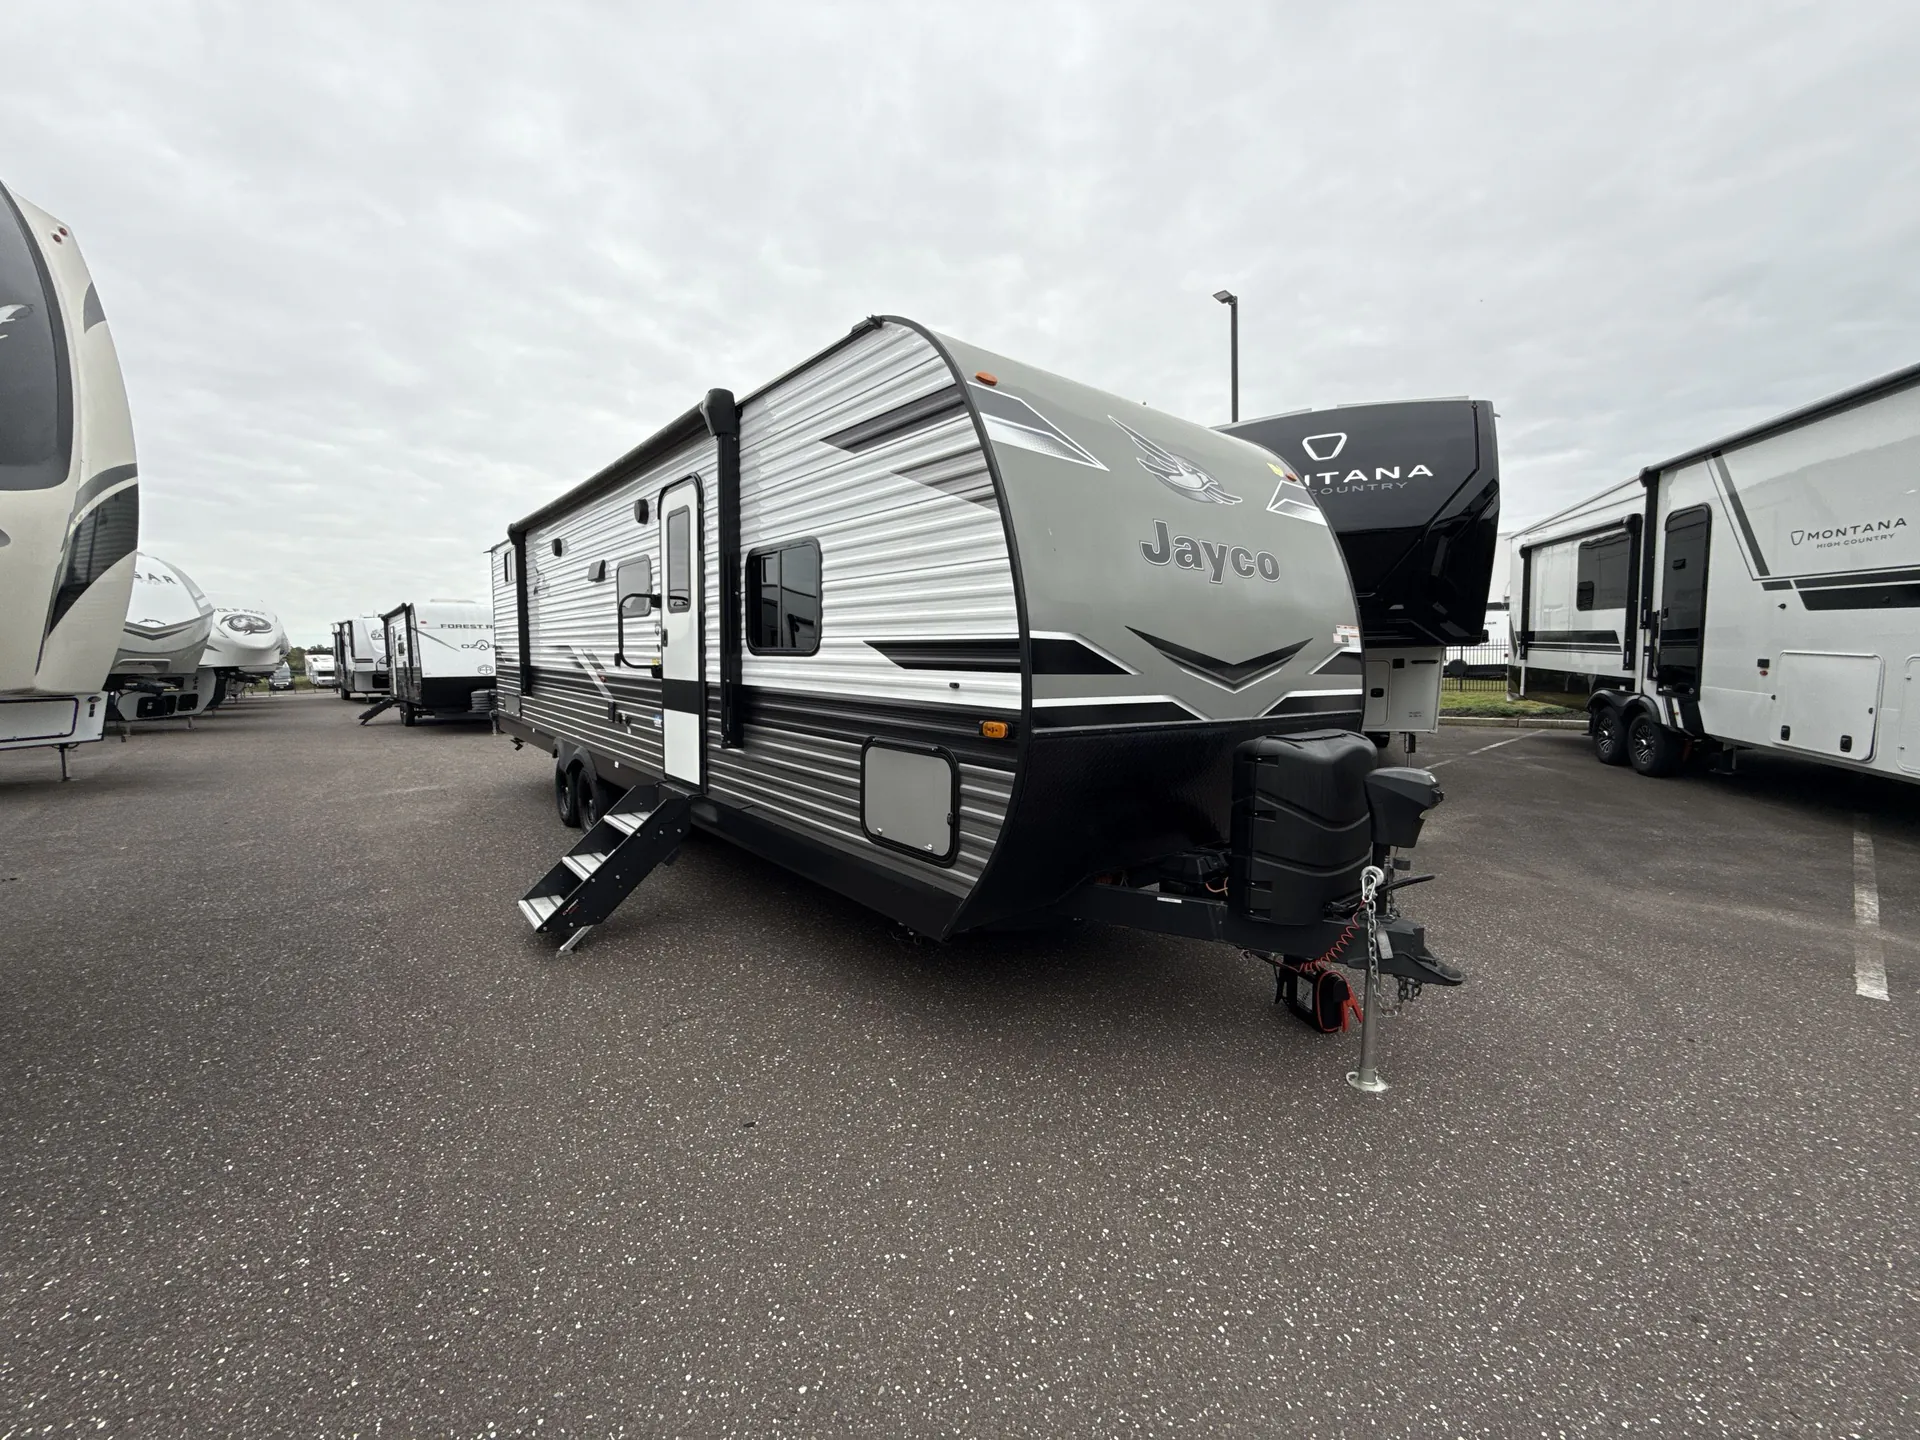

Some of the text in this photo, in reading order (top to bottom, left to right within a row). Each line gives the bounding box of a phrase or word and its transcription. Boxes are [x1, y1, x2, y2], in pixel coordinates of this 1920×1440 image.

[1807, 517, 1907, 541] MONTANA
[1816, 532, 1896, 549] HIGH COUNTRY
[1139, 518, 1280, 584] Jayco
